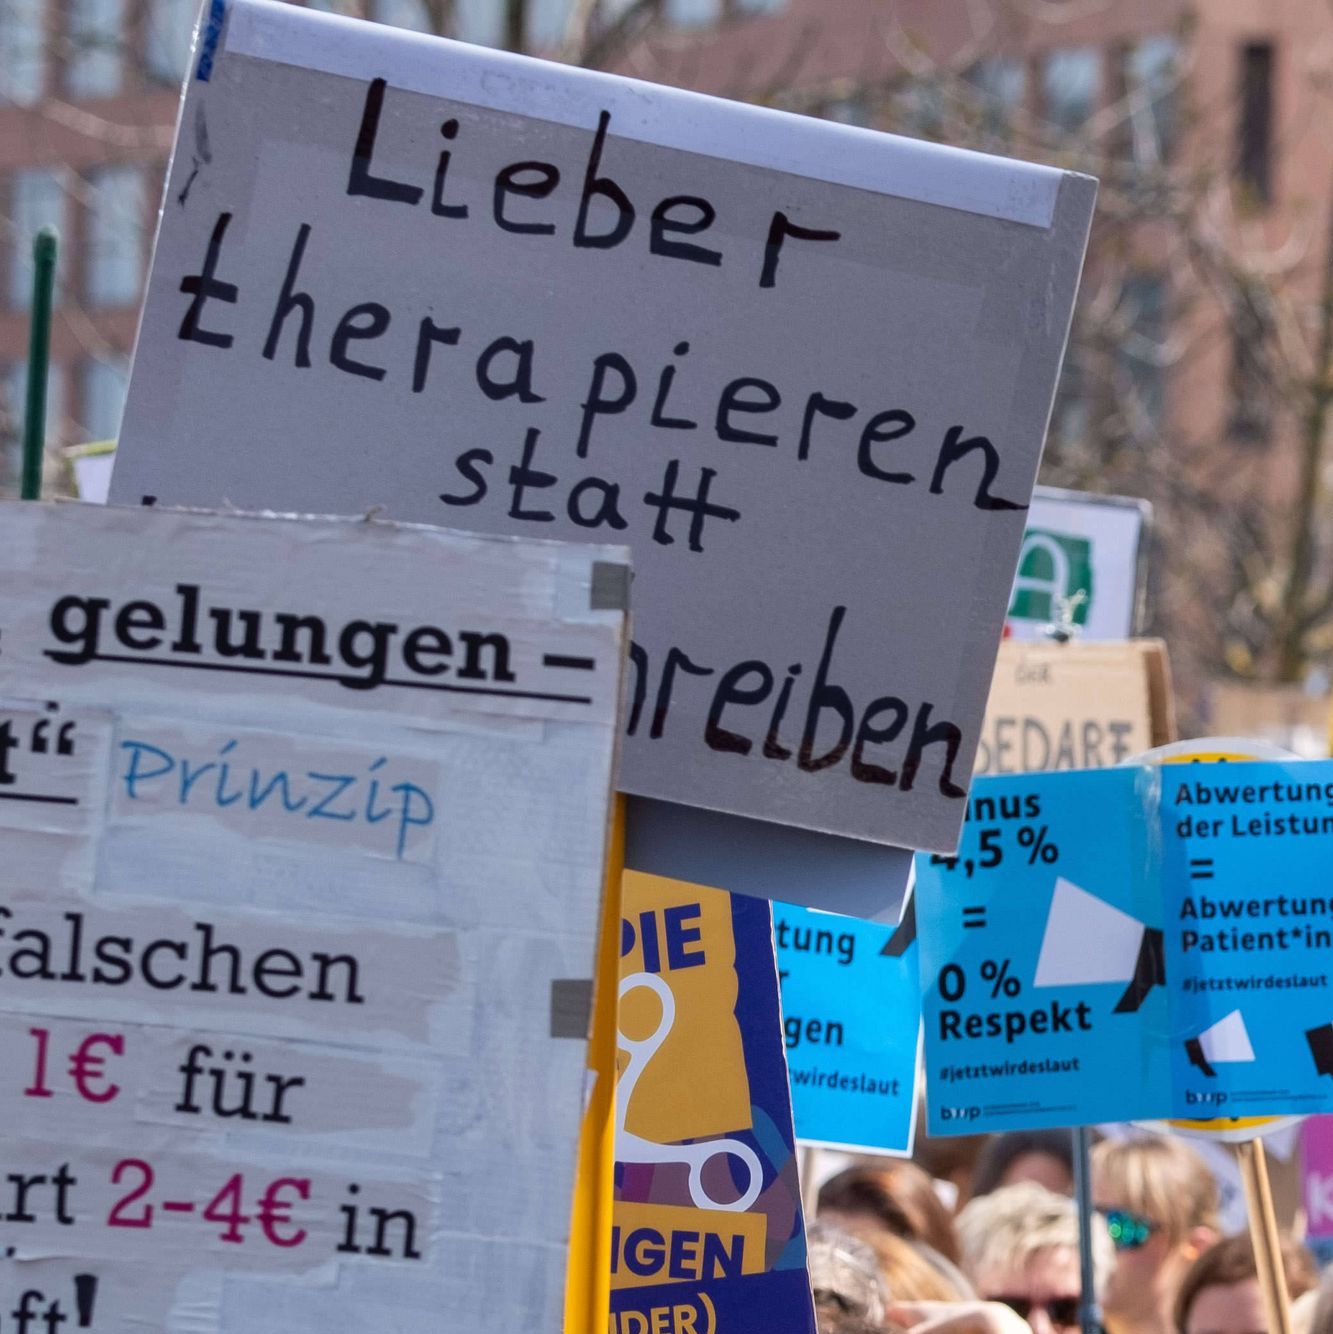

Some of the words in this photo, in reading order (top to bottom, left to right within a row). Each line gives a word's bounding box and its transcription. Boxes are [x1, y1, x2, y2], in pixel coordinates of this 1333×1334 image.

[346, 77, 841, 288] Lieber
[176, 212, 1030, 511] therapieren
[440, 428, 741, 551] statt
[50, 584, 516, 690] gelungen
[120, 740, 435, 861] Prinzip
[1017, 826, 1059, 866] %
[1176, 814, 1223, 837] der
[939, 963, 966, 1002] 0
[980, 959, 1020, 999] %
[939, 1001, 1093, 1044] Respekt
[1182, 972, 1328, 994] #jetztwirdeslaut
[24, 1028, 125, 1104] 1€
[174, 1045, 305, 1125] für
[940, 1056, 1080, 1084] #jetztwirdeslaut
[0, 1162, 77, 1226] rt
[107, 1158, 311, 1249] 2-4€
[337, 1184, 422, 1260] in
